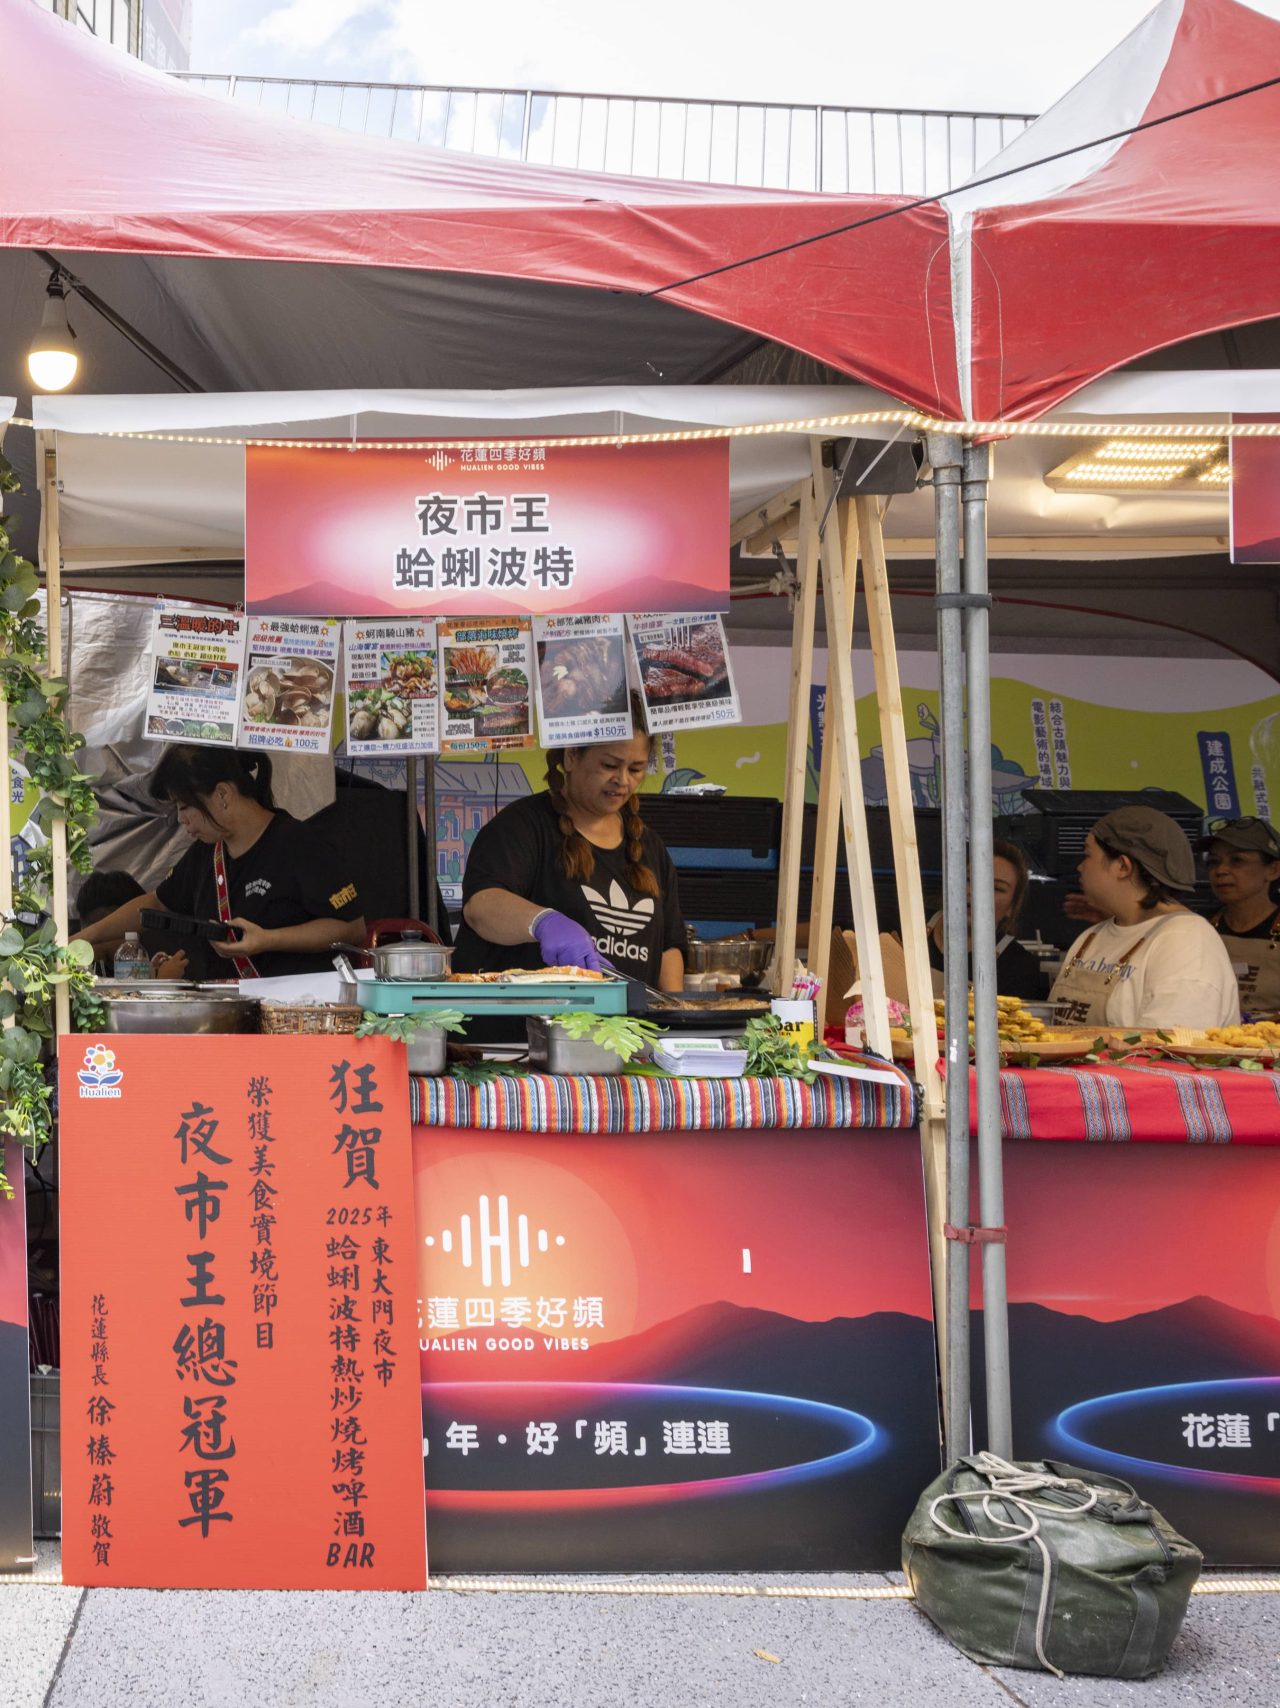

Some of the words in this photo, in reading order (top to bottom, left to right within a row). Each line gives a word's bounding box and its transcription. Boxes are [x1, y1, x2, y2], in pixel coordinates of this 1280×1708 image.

[460, 447, 546, 462] 花蓮四季好頻
[523, 463, 545, 471] VIBES
[417, 495, 550, 536] 夜市王
[394, 546, 574, 590] 蛤蜊波特
[270, 622, 320, 635] 最強蛤蜊燒
[248, 734, 283, 746] 招牌必吃
[295, 738, 319, 750] 100元
[1206, 740, 1232, 811] 建成公園
[79, 1086, 122, 1098] Hualien
[328, 1058, 384, 1190] 狂賀
[246, 1075, 279, 1350] 榮獲美食實境節目
[325, 1205, 393, 1229] 2025年
[172, 1101, 238, 1539] 夜市王總冠軍
[371, 1236, 398, 1388] 東大門夜市
[418, 1295, 605, 1329] 蓮四季好頻
[419, 1338, 478, 1352] UALIEN
[485, 1337, 535, 1351] GOOD
[543, 1337, 590, 1351] VIBES
